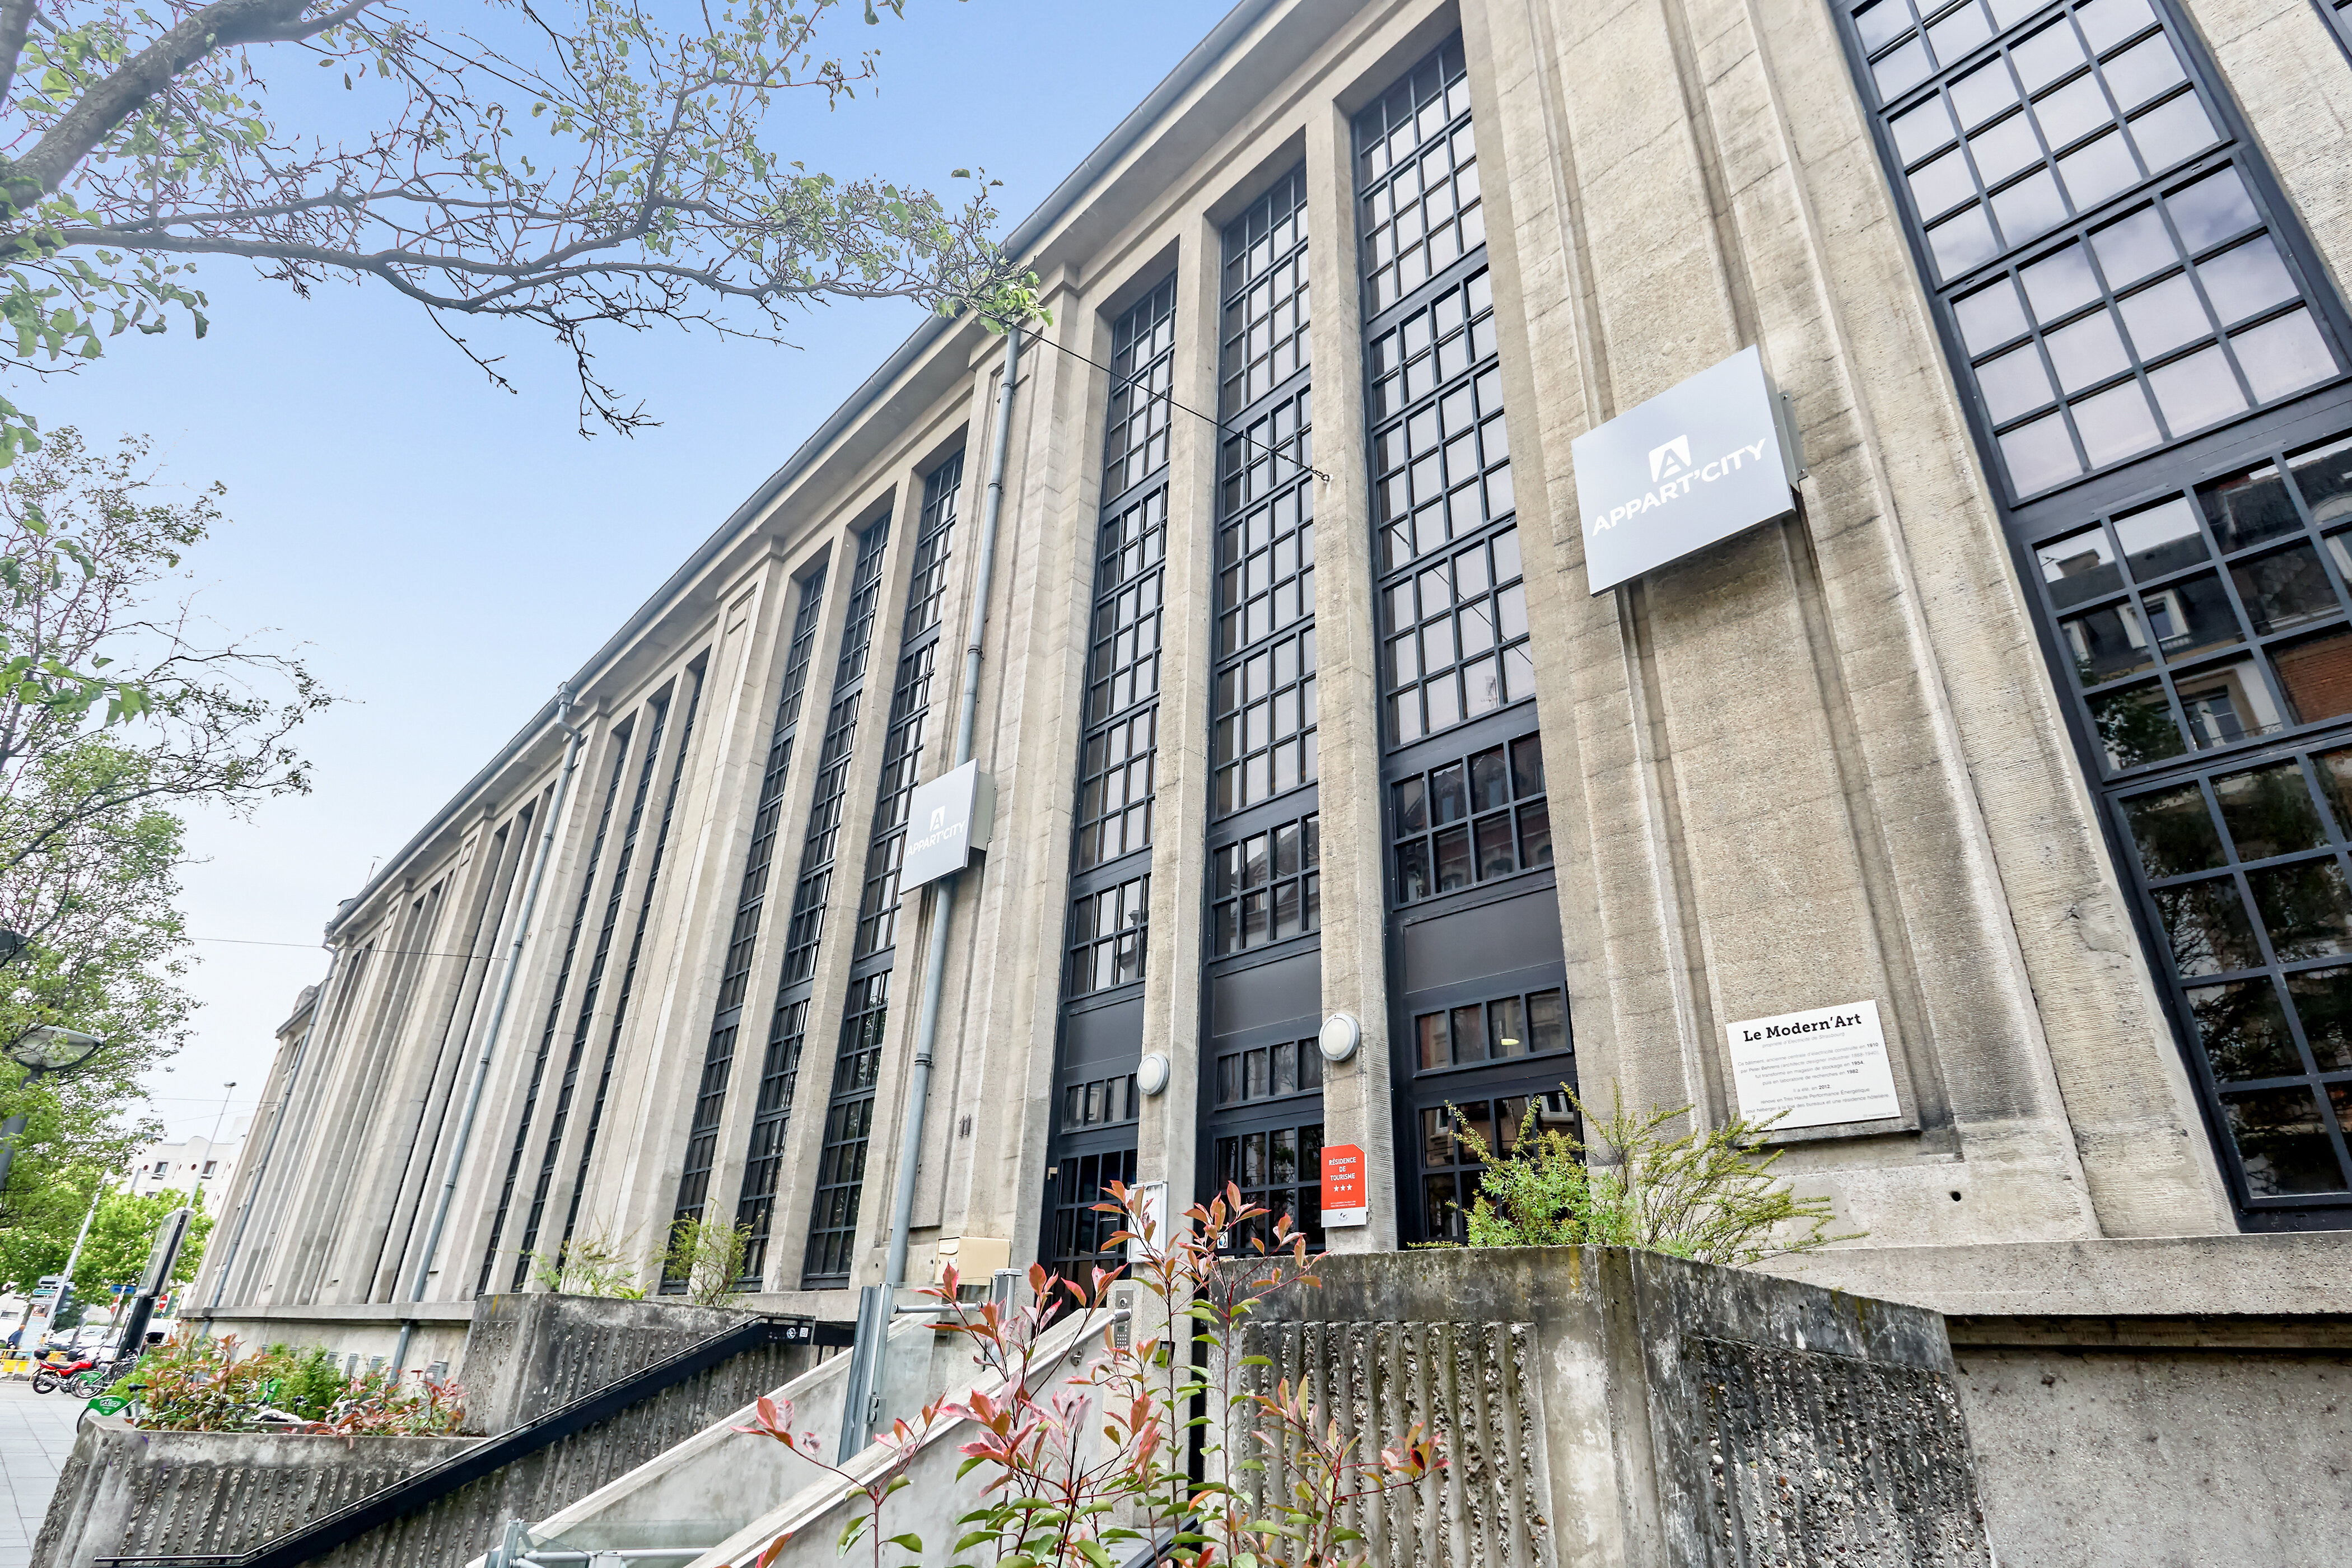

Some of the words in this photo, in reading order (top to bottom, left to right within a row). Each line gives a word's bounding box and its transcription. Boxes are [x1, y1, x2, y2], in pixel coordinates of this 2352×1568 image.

[1592, 438, 1766, 536] APPART'CITY
[1743, 1030, 1761, 1042] Le
[1766, 1014, 1862, 1038] Modern'Art
[1329, 1157, 1356, 1165] RÉSIDENCE
